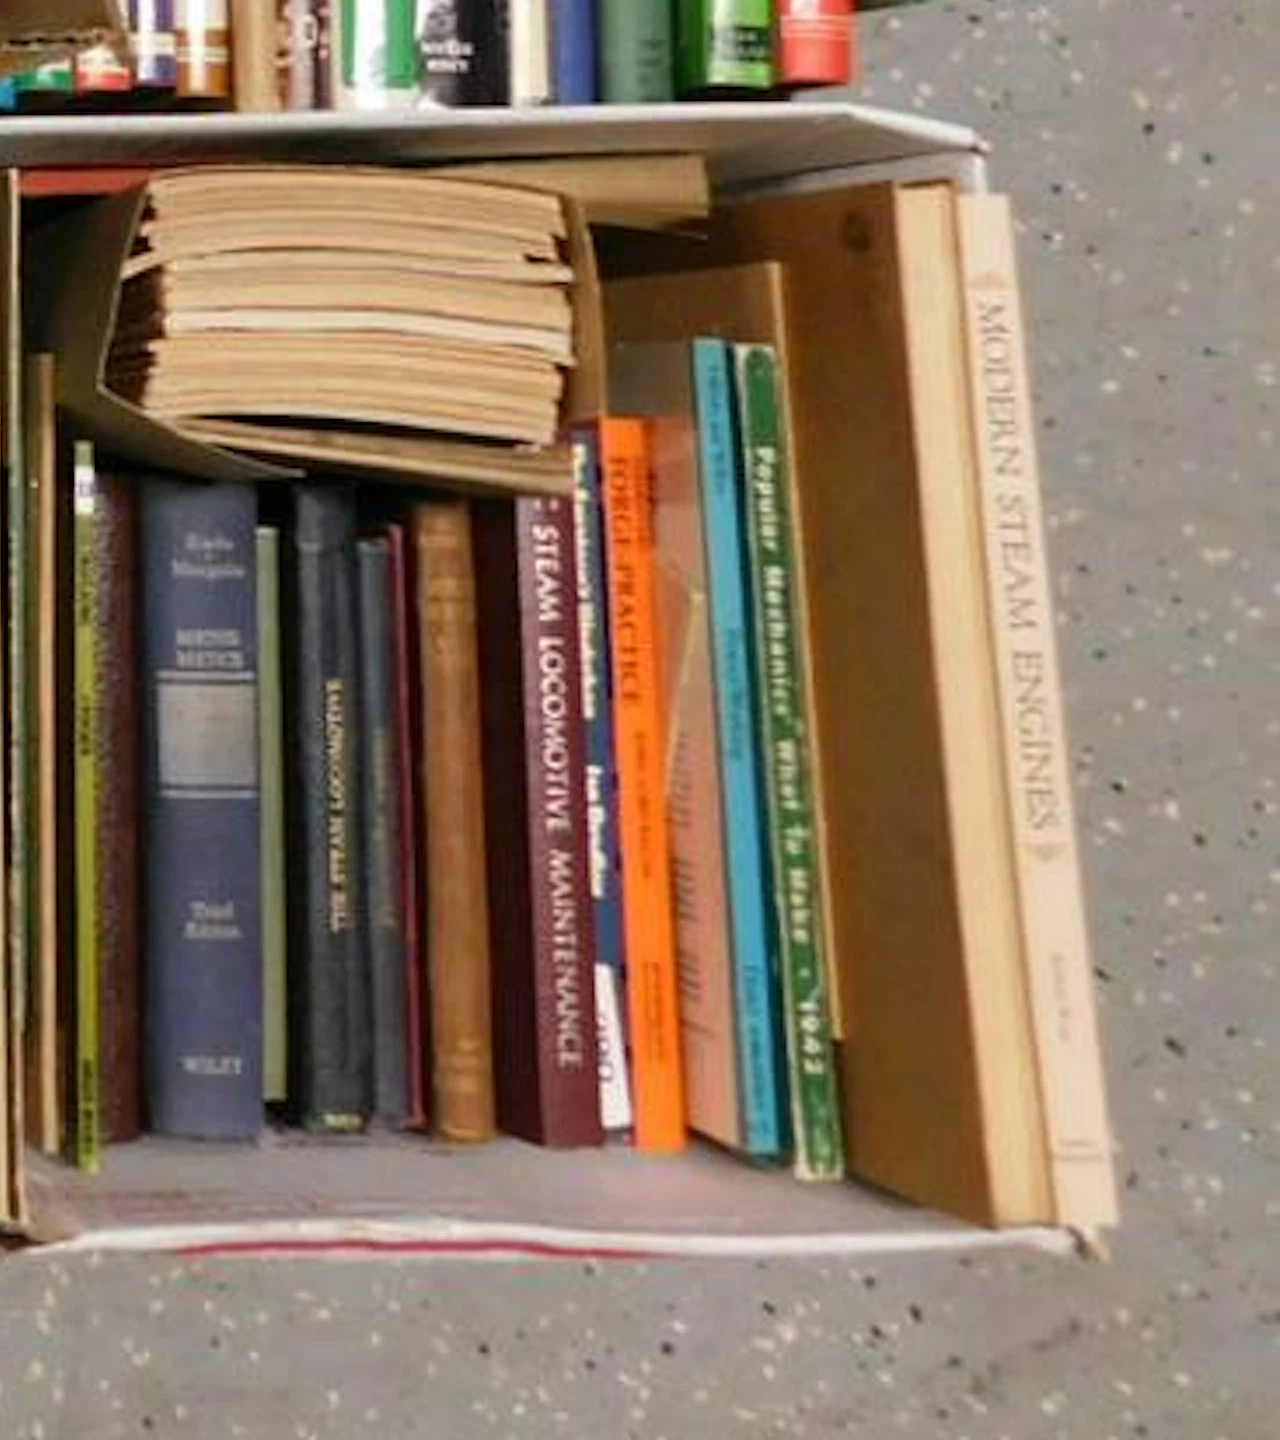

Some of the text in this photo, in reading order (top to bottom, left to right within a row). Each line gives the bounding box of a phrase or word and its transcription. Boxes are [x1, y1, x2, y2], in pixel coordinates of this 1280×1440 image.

[753, 447, 783, 551] Popular
[975, 300, 1058, 832] MODERN STEAM ENGINES
[614, 561, 643, 707] PRACTICE
[530, 524, 584, 1068] STEAM LOCOMOTIVE MAINTENANCE
[776, 740, 804, 812] What
[781, 827, 807, 856] To
[786, 868, 813, 946] Make
